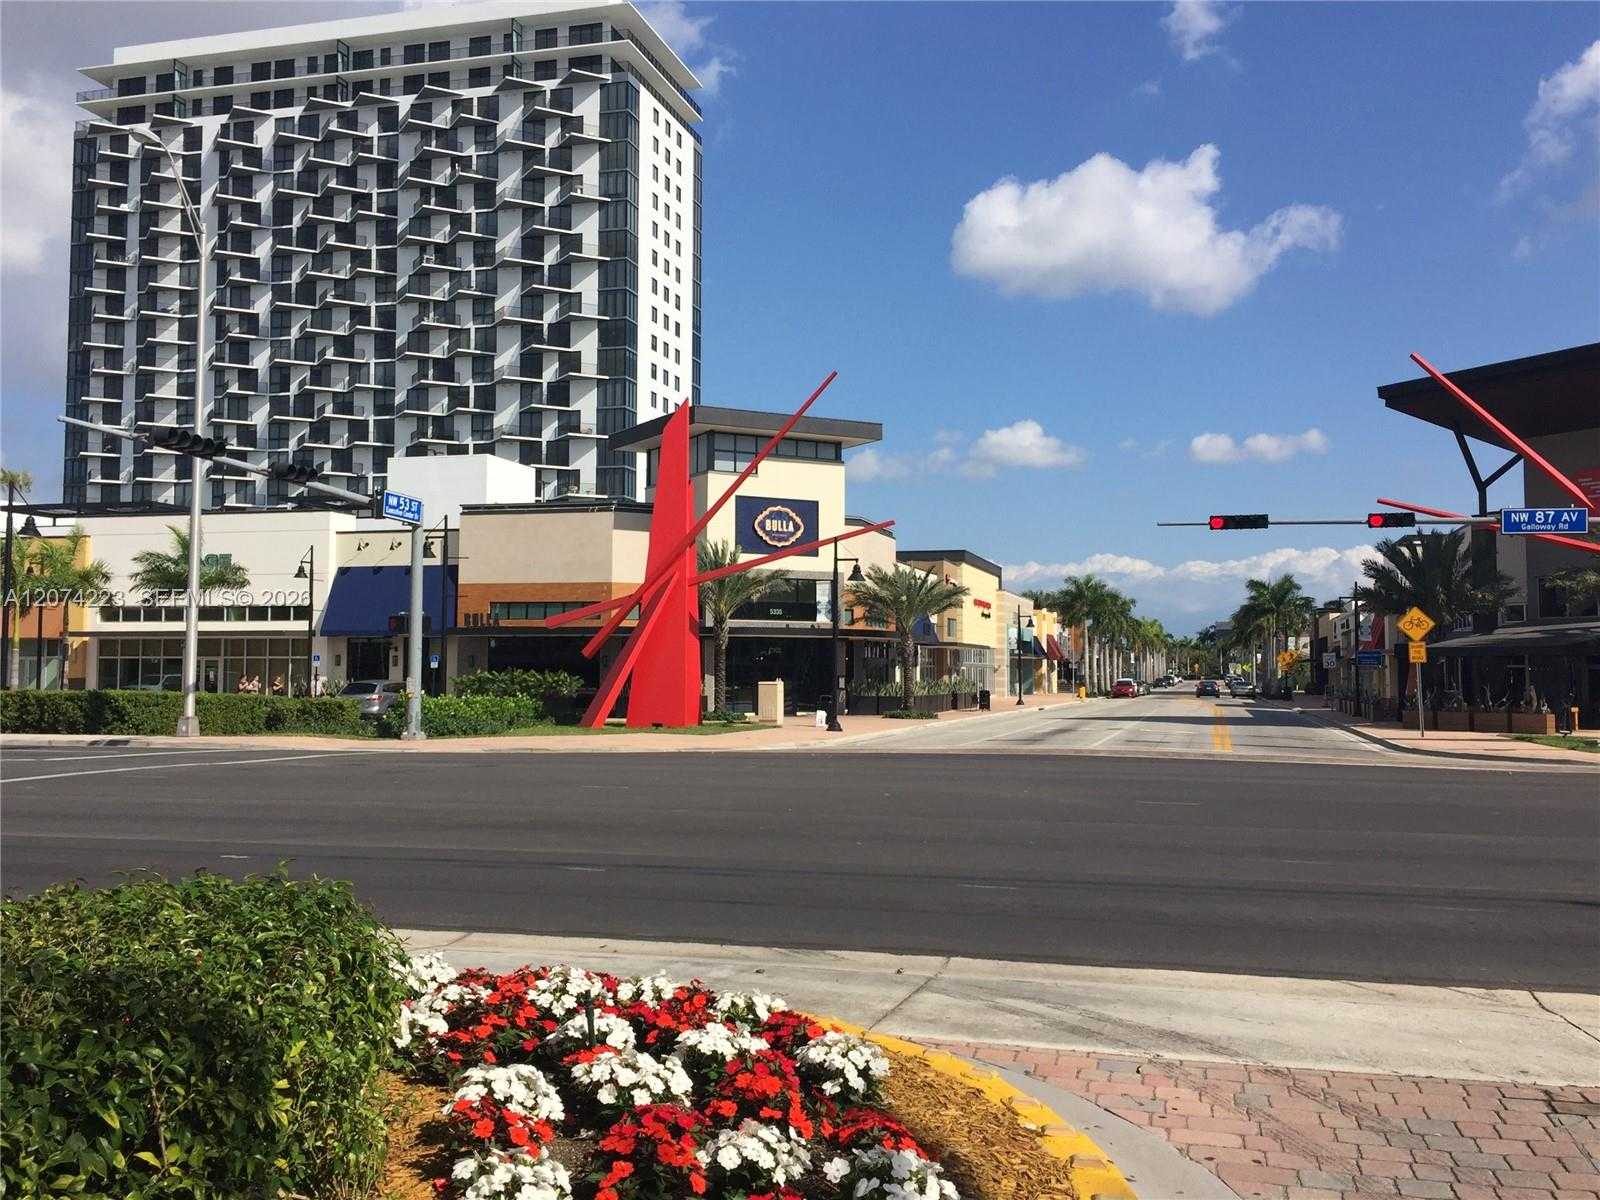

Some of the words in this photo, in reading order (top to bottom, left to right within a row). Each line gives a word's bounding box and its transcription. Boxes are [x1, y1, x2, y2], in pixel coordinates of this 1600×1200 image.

[388, 495, 398, 506] NW
[400, 496, 410, 511] 53
[411, 501, 418, 512] ST
[1511, 512, 1529, 522] NW
[1535, 511, 1555, 523] 87
[1561, 511, 1578, 522] AV
[765, 519, 794, 532] BULLA
[1521, 523, 1556, 531] Galloway
